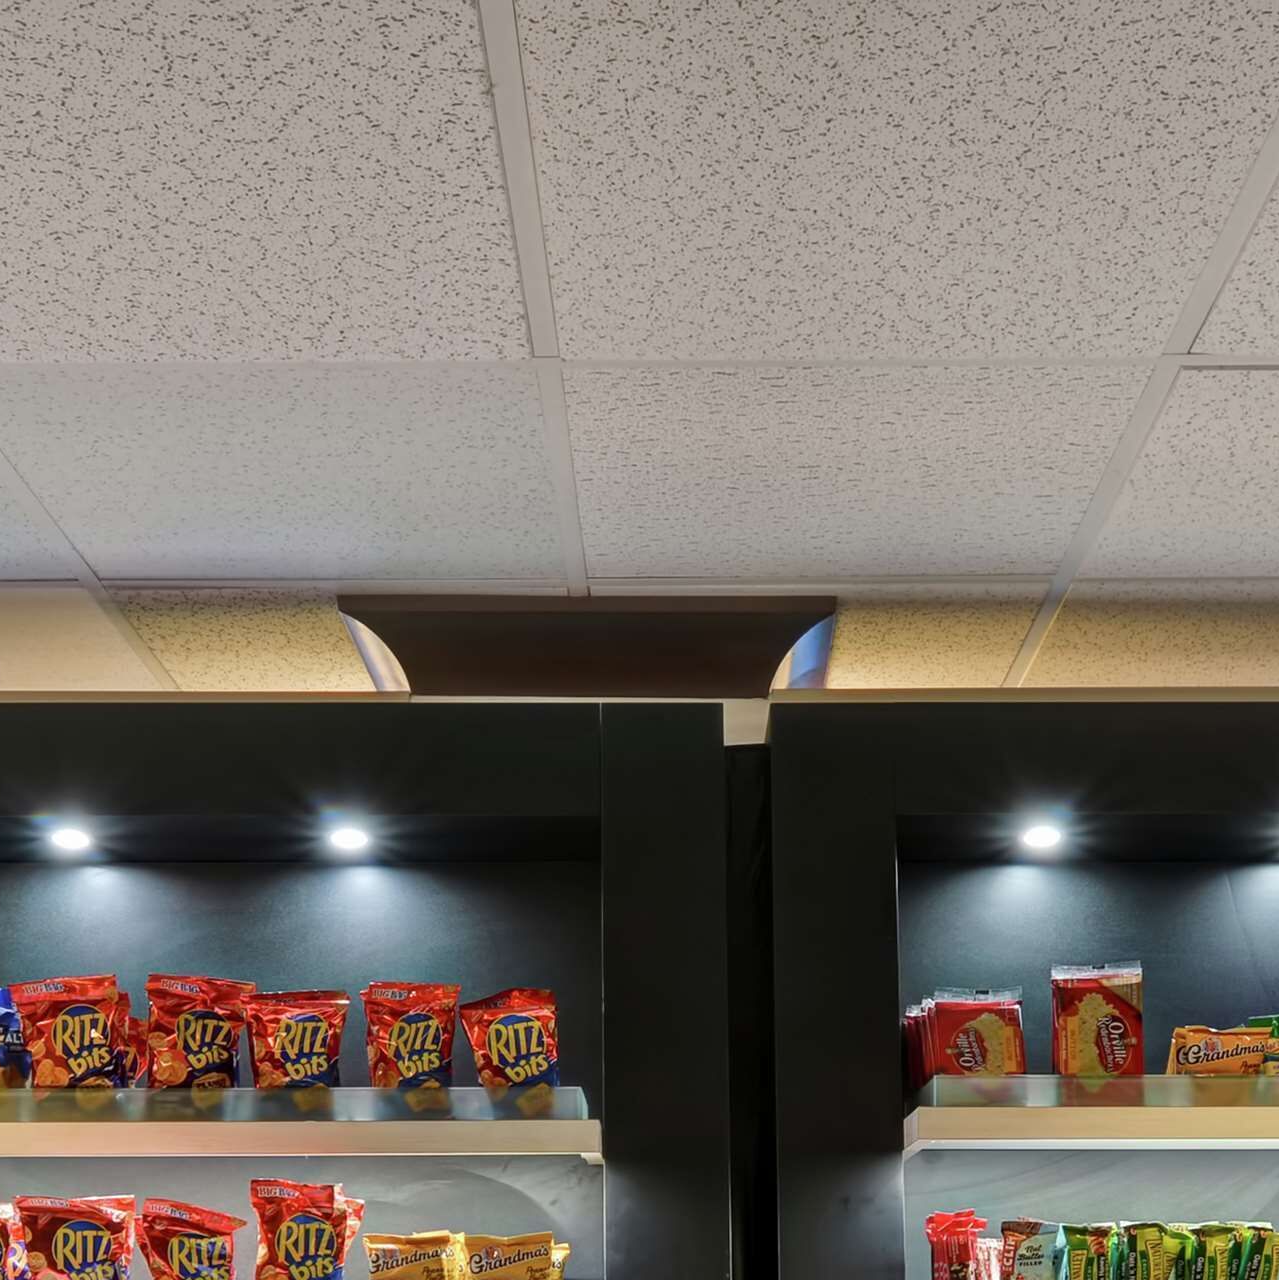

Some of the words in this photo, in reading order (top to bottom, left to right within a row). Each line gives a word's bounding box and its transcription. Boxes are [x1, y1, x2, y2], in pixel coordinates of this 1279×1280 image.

[51, 1013, 108, 1058] RITZ
[175, 1013, 232, 1058] RITZ
[275, 1018, 329, 1060] RITZ
[387, 1017, 442, 1060] RITZ
[487, 1018, 544, 1069] RITZ
[958, 1032, 972, 1071] Orville
[1109, 1021, 1125, 1065] Orville
[1187, 1041, 1266, 1065] Grandma's
[69, 1046, 112, 1076] bits
[187, 1048, 230, 1073] bits
[285, 1053, 328, 1081] bits
[396, 1051, 442, 1079] bits
[505, 1055, 550, 1083] bits
[53, 1226, 112, 1270] RITZ
[169, 1235, 227, 1279] RITZ
[276, 1221, 335, 1264] RITZ
[470, 1245, 549, 1275] Grandma's
[1016, 1253, 1045, 1262] Butter
[1024, 1244, 1043, 1255] Nut
